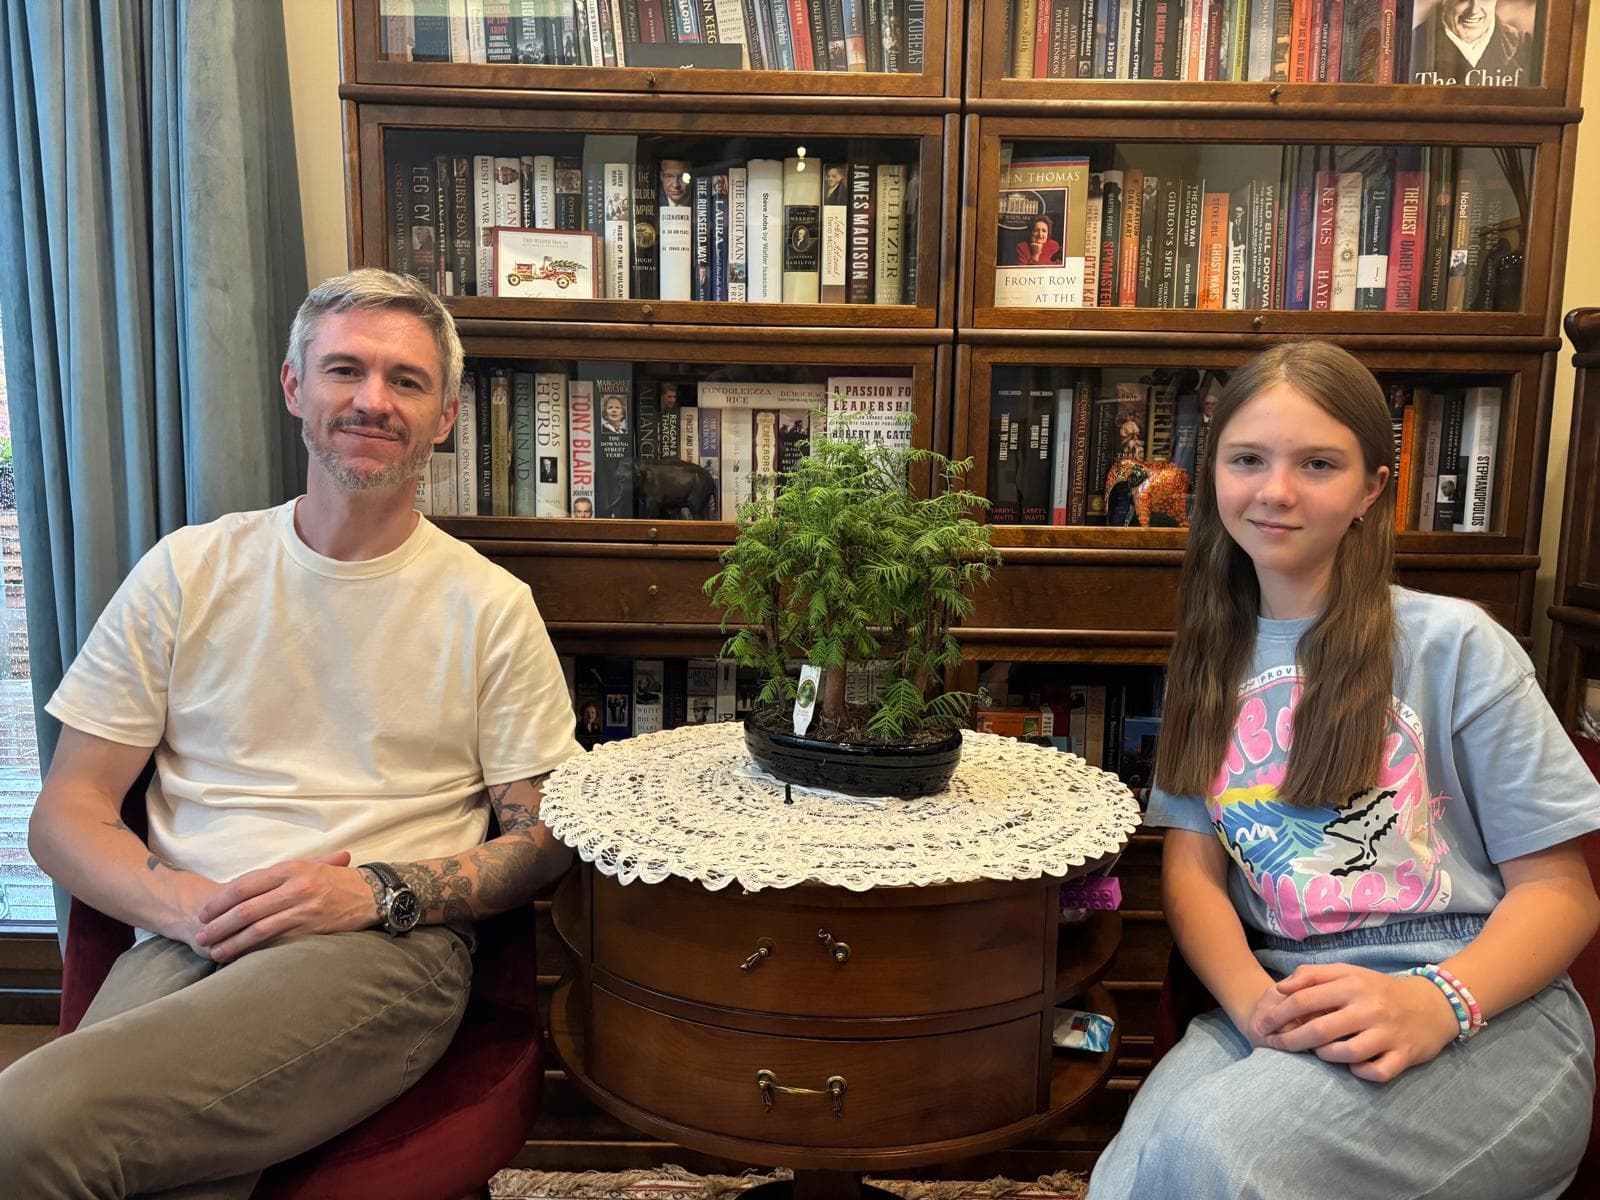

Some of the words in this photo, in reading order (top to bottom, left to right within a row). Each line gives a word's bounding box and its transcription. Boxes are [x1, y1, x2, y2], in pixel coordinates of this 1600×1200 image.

[1055, 9, 1065, 41] PATRICK
[1154, 14, 1167, 43] BALKANS
[1321, 23, 1329, 48] TURKEY
[1132, 27, 1142, 52] Modern
[1190, 31, 1200, 58] Greece
[1052, 42, 1062, 75] KINROSS
[1106, 41, 1116, 73] GREECE
[1153, 62, 1164, 78] 1453
[1320, 49, 1328, 79] DECODED
[1415, 72, 1456, 86] The
[1458, 68, 1524, 86] Chief
[480, 158, 490, 184] BUSH
[617, 169, 625, 188] JAMES
[1029, 172, 1081, 183] THOMAS
[455, 178, 468, 208] FIRST
[481, 188, 489, 201] AT
[698, 180, 707, 195] THE
[734, 180, 745, 198] THE
[852, 163, 871, 210] JAMES
[1127, 188, 1135, 210] DARK
[1190, 184, 1199, 202] THE
[1404, 186, 1420, 205] THE
[482, 203, 490, 225] WAR
[1133, 192, 1141, 237] OPERATION
[1189, 203, 1198, 226] COLD
[1211, 198, 1220, 219] STEVE
[1264, 185, 1273, 219] WILD
[1458, 191, 1470, 218] Nobel
[456, 211, 468, 238] SON
[715, 199, 724, 245] LAURA
[734, 201, 745, 232] RIGHT
[761, 213, 769, 231] Jobs
[826, 216, 834, 234] DAVID
[887, 173, 902, 279] PULITZER
[1126, 212, 1134, 239] HEART
[1165, 191, 1177, 247] GIDEON'S
[1210, 221, 1219, 238] COLL
[1320, 187, 1336, 245] KEYNES
[1371, 206, 1382, 246] Liechtenstein
[1401, 206, 1418, 236] QUEST
[617, 244, 624, 254] OF
[734, 235, 745, 261] MAN
[760, 232, 769, 241] by
[852, 213, 870, 280] MADISON
[1188, 227, 1197, 248] WAR
[1263, 222, 1272, 254] BILL
[616, 256, 624, 270] THE
[697, 245, 707, 265] WAY
[761, 242, 769, 265] Walter
[1164, 250, 1174, 279] SPIES
[1210, 243, 1222, 273] GHOST
[1232, 249, 1241, 266] THE
[1398, 240, 1416, 273] DANIEL
[761, 266, 769, 298] Isaacson
[1004, 276, 1045, 287] FRONT
[1048, 275, 1077, 286] ROW
[1084, 256, 1097, 285] OTTO
[1100, 241, 1114, 307] SPYMASTER
[1232, 267, 1240, 285] LOST
[1034, 294, 1049, 303] AT
[1053, 294, 1076, 303] THE
[1209, 274, 1221, 300] WARS
[1231, 286, 1240, 304] SPY
[1315, 269, 1330, 309] HAYE
[1395, 274, 1411, 308] YERGIN
[702, 387, 772, 396] CONDOLEEZZA
[726, 396, 749, 404] RICE
[834, 386, 841, 395] A
[845, 386, 893, 396] PASSION
[461, 395, 470, 423] BLAIR'S
[517, 382, 530, 449] BRITAIN
[537, 382, 550, 447] HURD
[552, 382, 561, 448] DOUGLAS
[571, 393, 592, 434] TONY
[1077, 390, 1089, 434] CROMWELL
[461, 424, 470, 445] WARS
[640, 385, 655, 464] ALLIANCE
[662, 413, 670, 457] THATCHER
[669, 414, 678, 449] REAGAN
[686, 415, 694, 434] FINEST
[832, 430, 871, 439] ROBERT
[1152, 391, 1173, 457] BERLIN
[483, 442, 491, 466] TONY
[686, 435, 694, 447] AND
[709, 433, 717, 450] FOUR
[761, 423, 770, 473] EMPERORS
[1077, 436, 1085, 448] TO
[462, 448, 470, 470] JOHN
[517, 455, 530, 481] AD
[571, 438, 593, 485] BLAIR
[1074, 448, 1084, 494] CROMWELL
[462, 471, 471, 513] KAMPFNER
[1471, 455, 1490, 526] STEPHANOPOULOS
